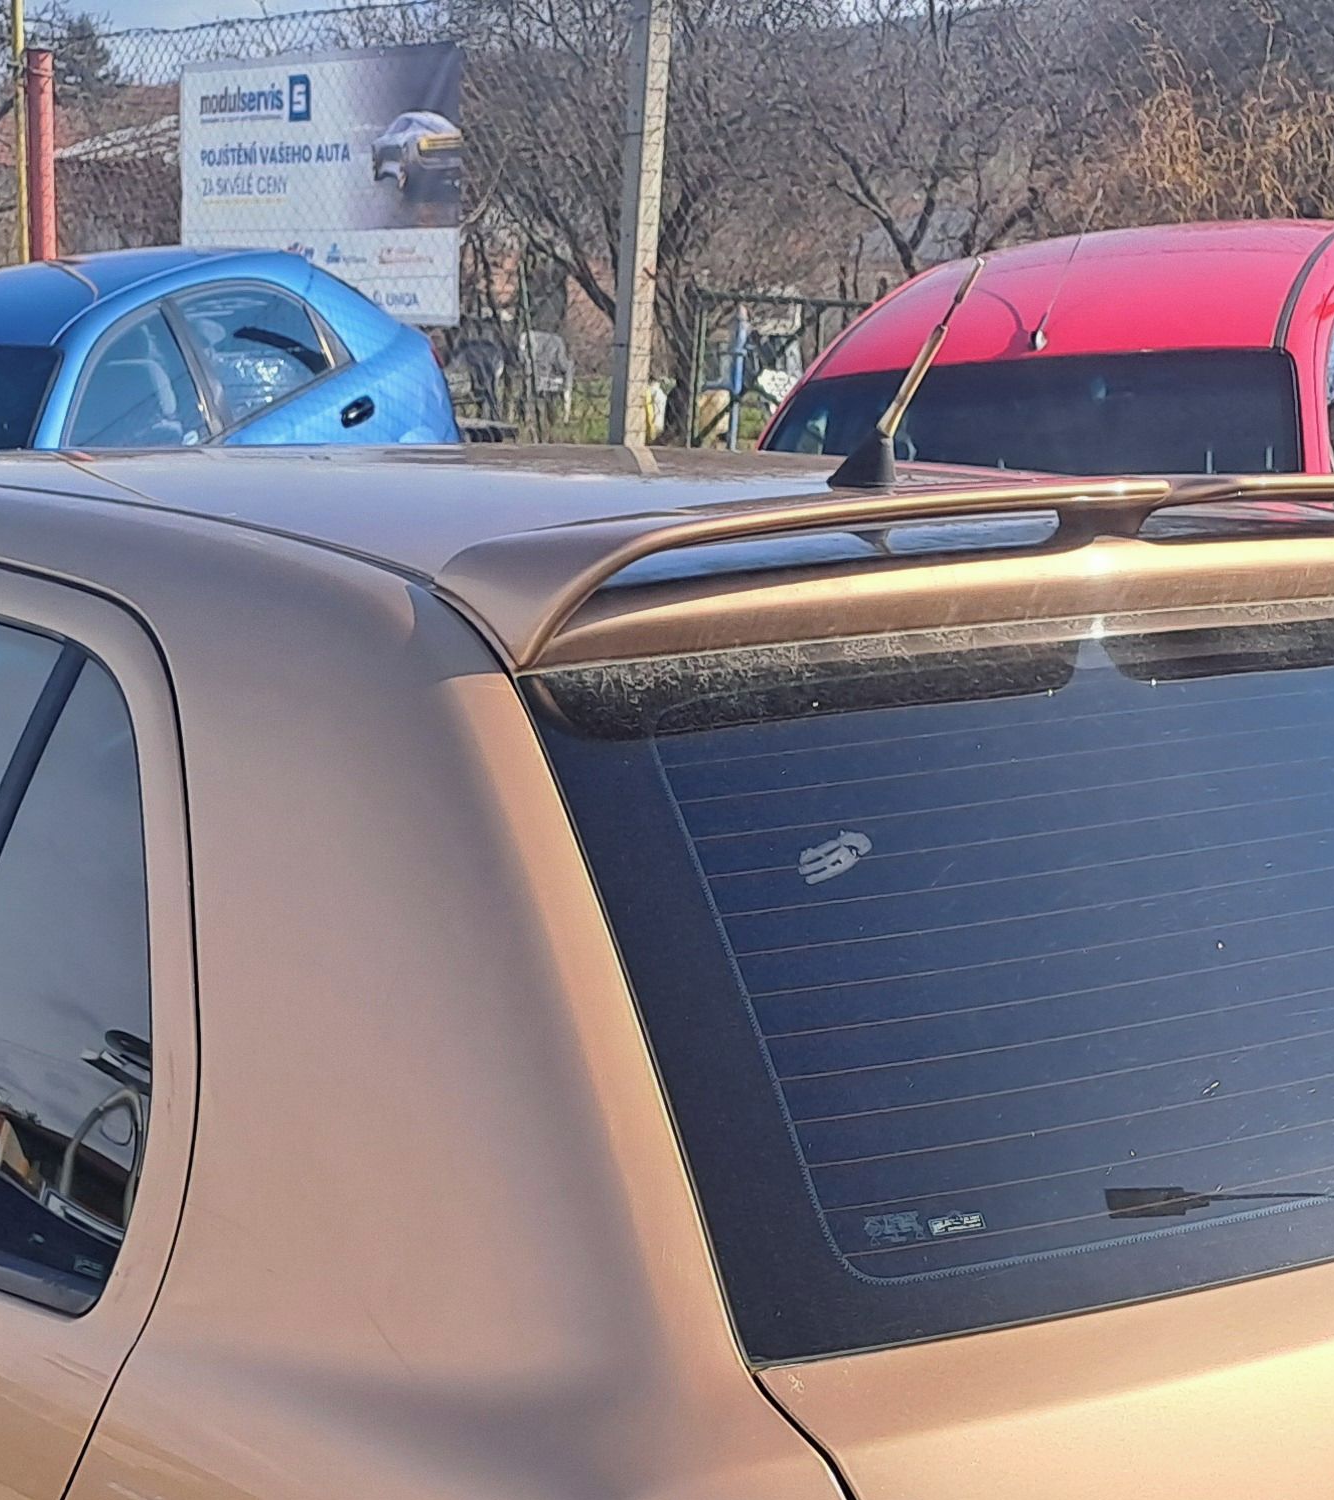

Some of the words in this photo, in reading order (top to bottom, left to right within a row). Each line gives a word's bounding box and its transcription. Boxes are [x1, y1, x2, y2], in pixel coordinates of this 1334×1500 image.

[199, 83, 284, 116] modulservis
[259, 142, 313, 165] VAŠEHO
[315, 142, 351, 163] AUTA
[202, 178, 214, 197] ZA
[256, 175, 288, 195] CENY
